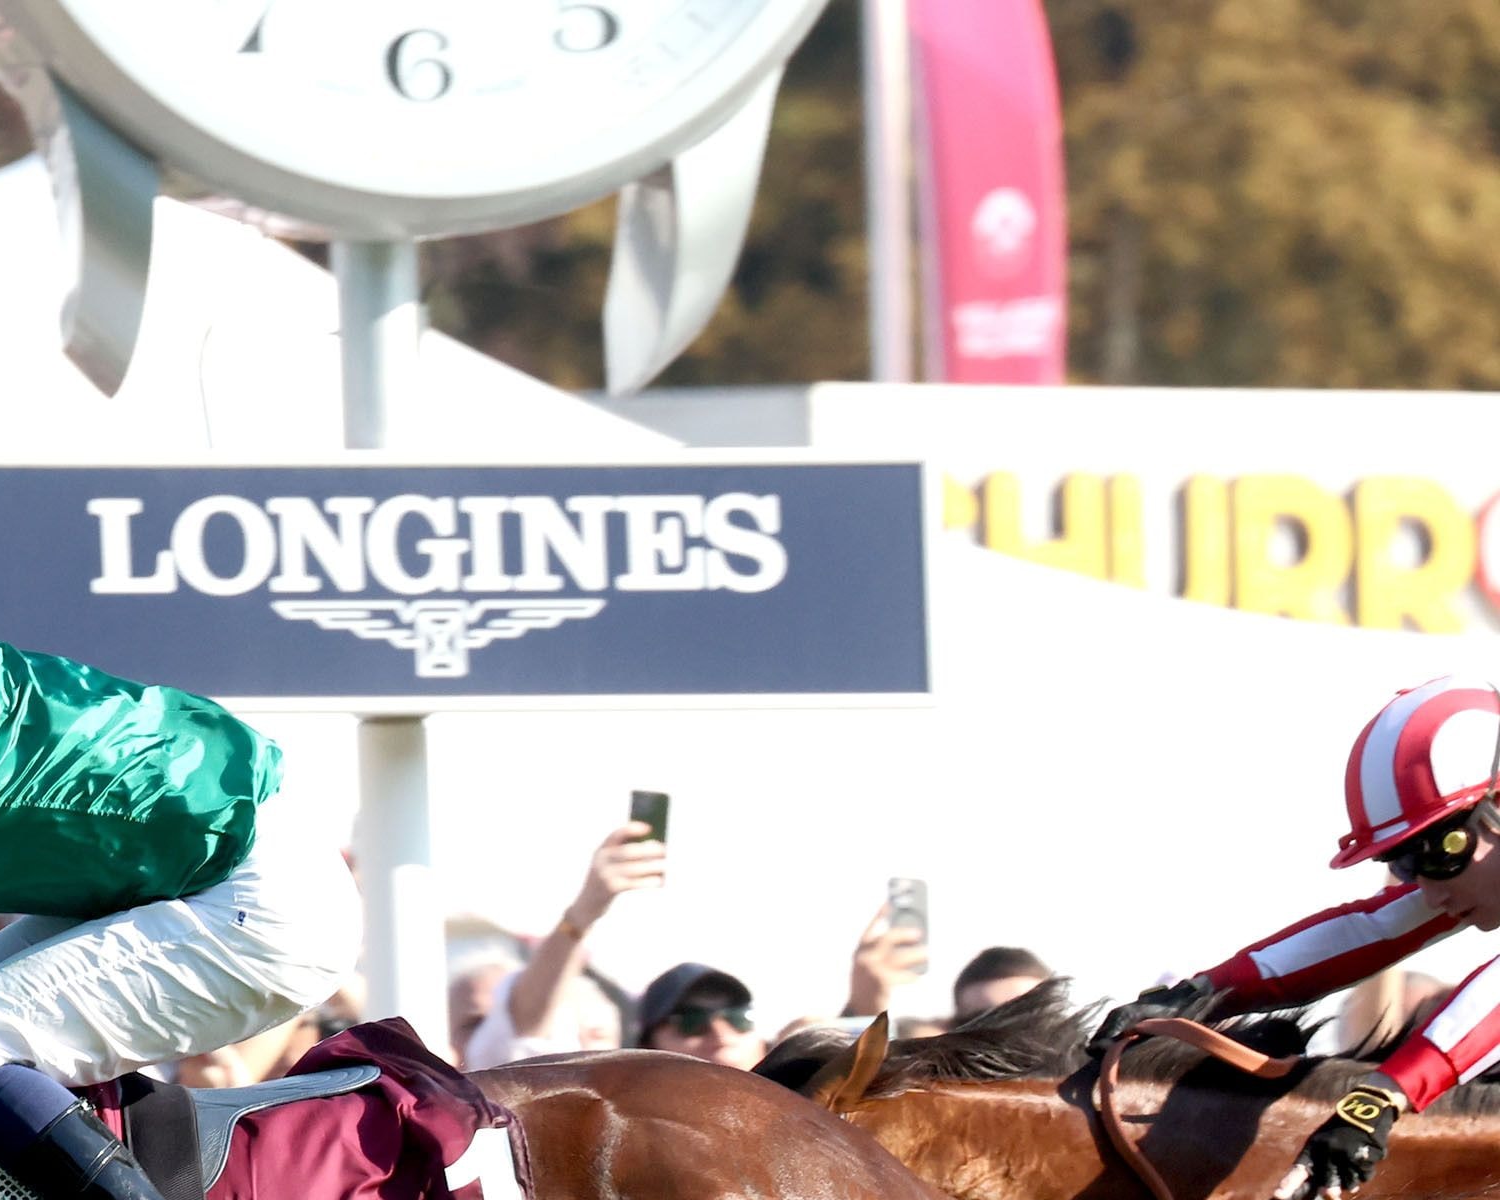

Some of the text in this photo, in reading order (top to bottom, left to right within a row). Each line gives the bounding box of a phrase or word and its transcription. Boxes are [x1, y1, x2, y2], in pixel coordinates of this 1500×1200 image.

[383, 28, 453, 101] 6
[88, 494, 788, 597] LONGINES
[942, 471, 1500, 635] HURR
